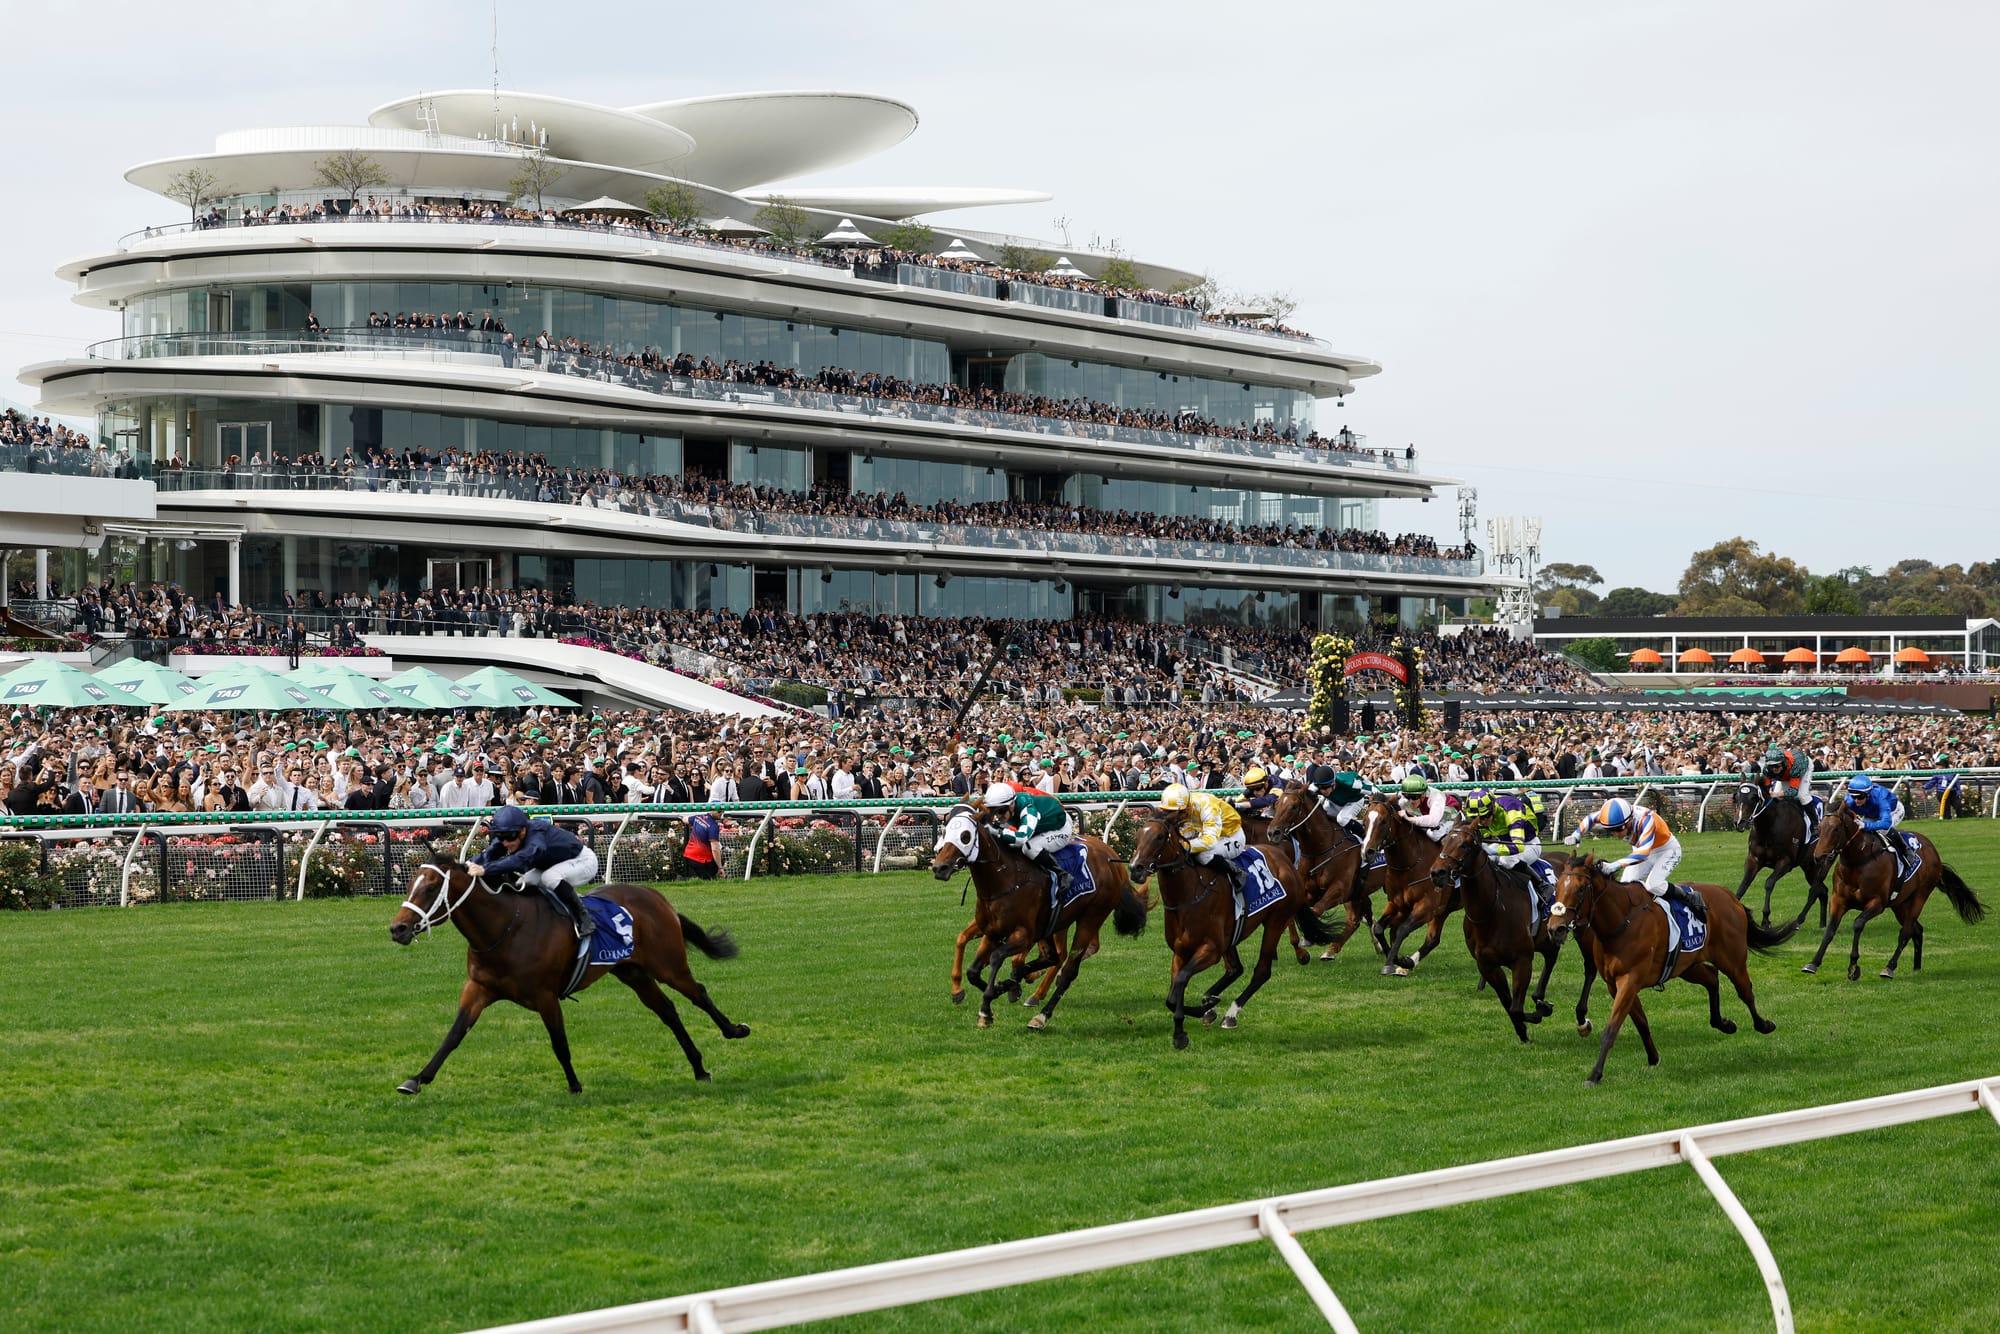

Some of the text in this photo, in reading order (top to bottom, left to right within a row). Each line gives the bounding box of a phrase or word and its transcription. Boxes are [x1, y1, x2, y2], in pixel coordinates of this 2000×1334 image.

[1362, 656, 1382, 665] VICTORIA
[1382, 659, 1395, 671] DERBY
[1396, 665, 1404, 675] DAY
[14, 684, 40, 693] TAB
[216, 689, 242, 698] TAB
[1247, 858, 1275, 895] 13
[611, 912, 633, 946] 5
